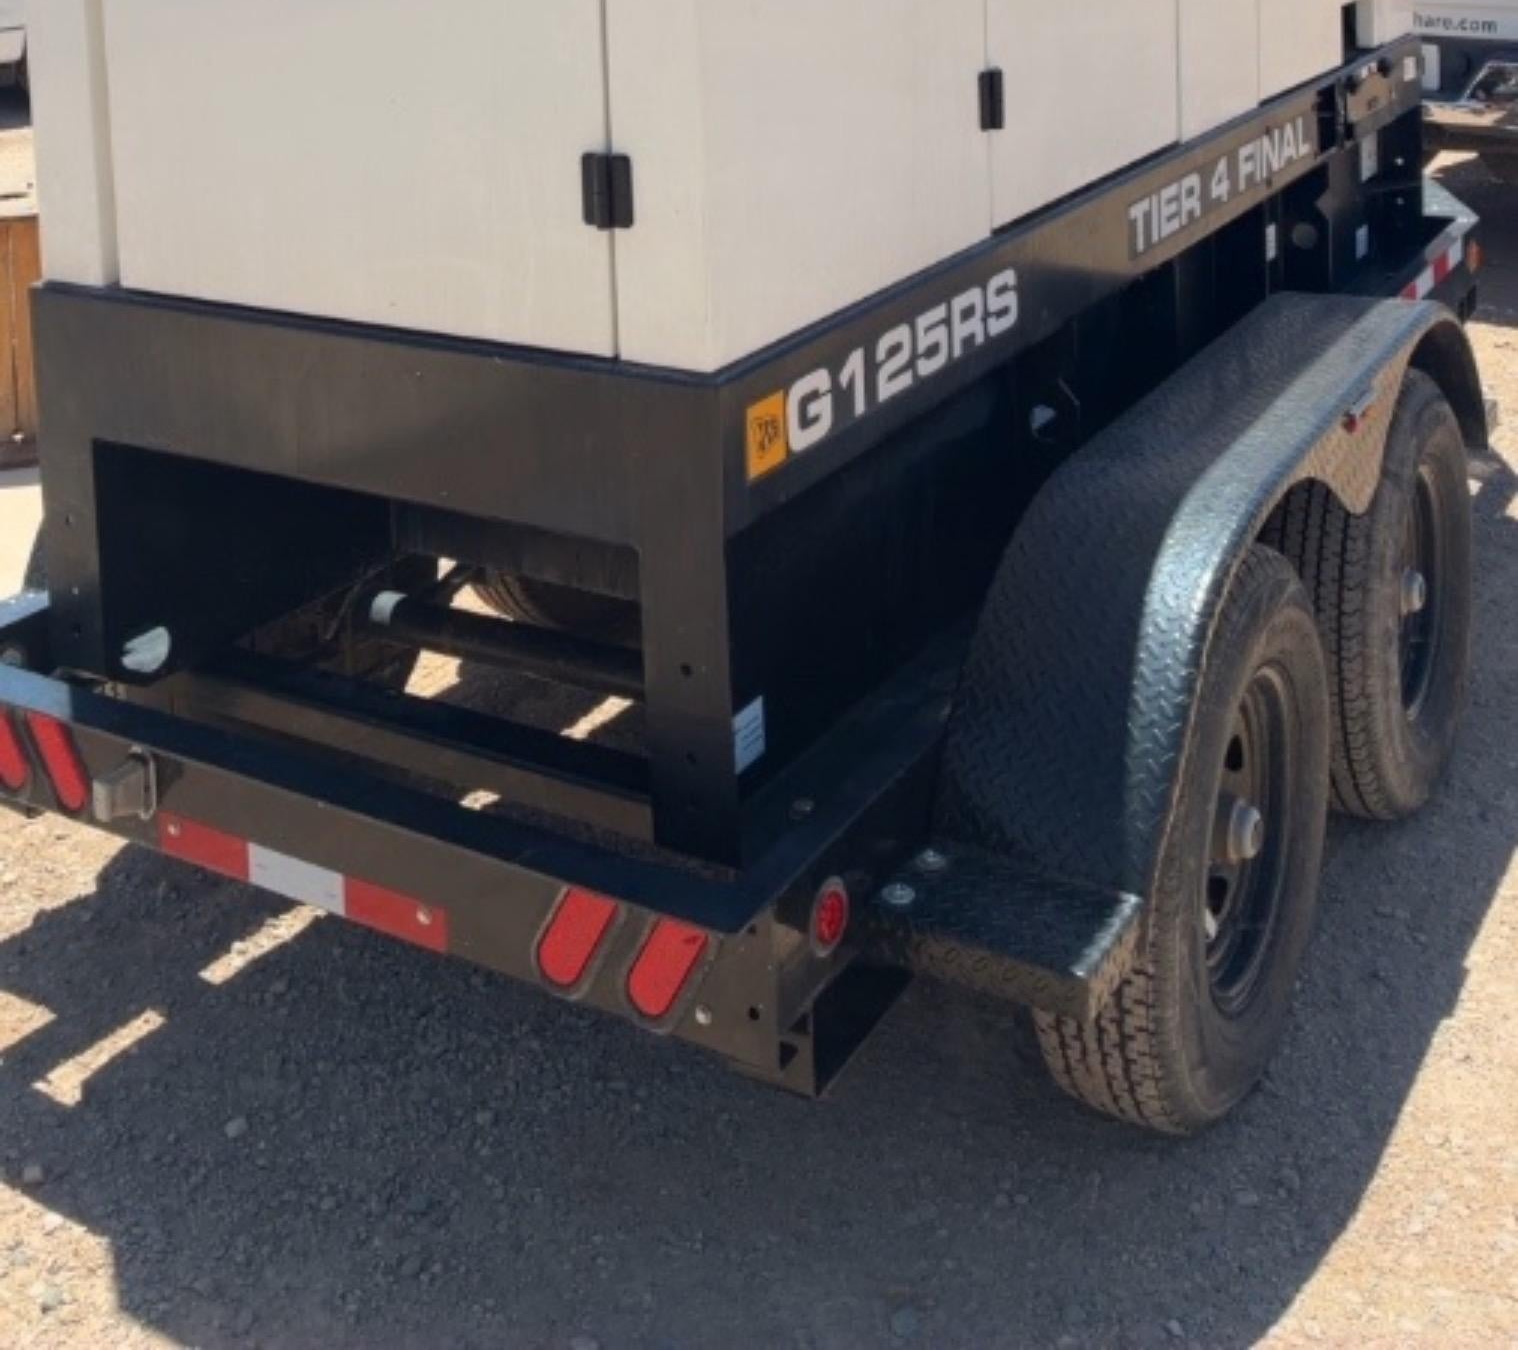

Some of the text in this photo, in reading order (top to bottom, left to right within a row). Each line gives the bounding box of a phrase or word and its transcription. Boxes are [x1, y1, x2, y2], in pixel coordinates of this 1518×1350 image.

[1128, 116, 1311, 254] TIER 4 FINAL
[787, 267, 1018, 453] G125RS
